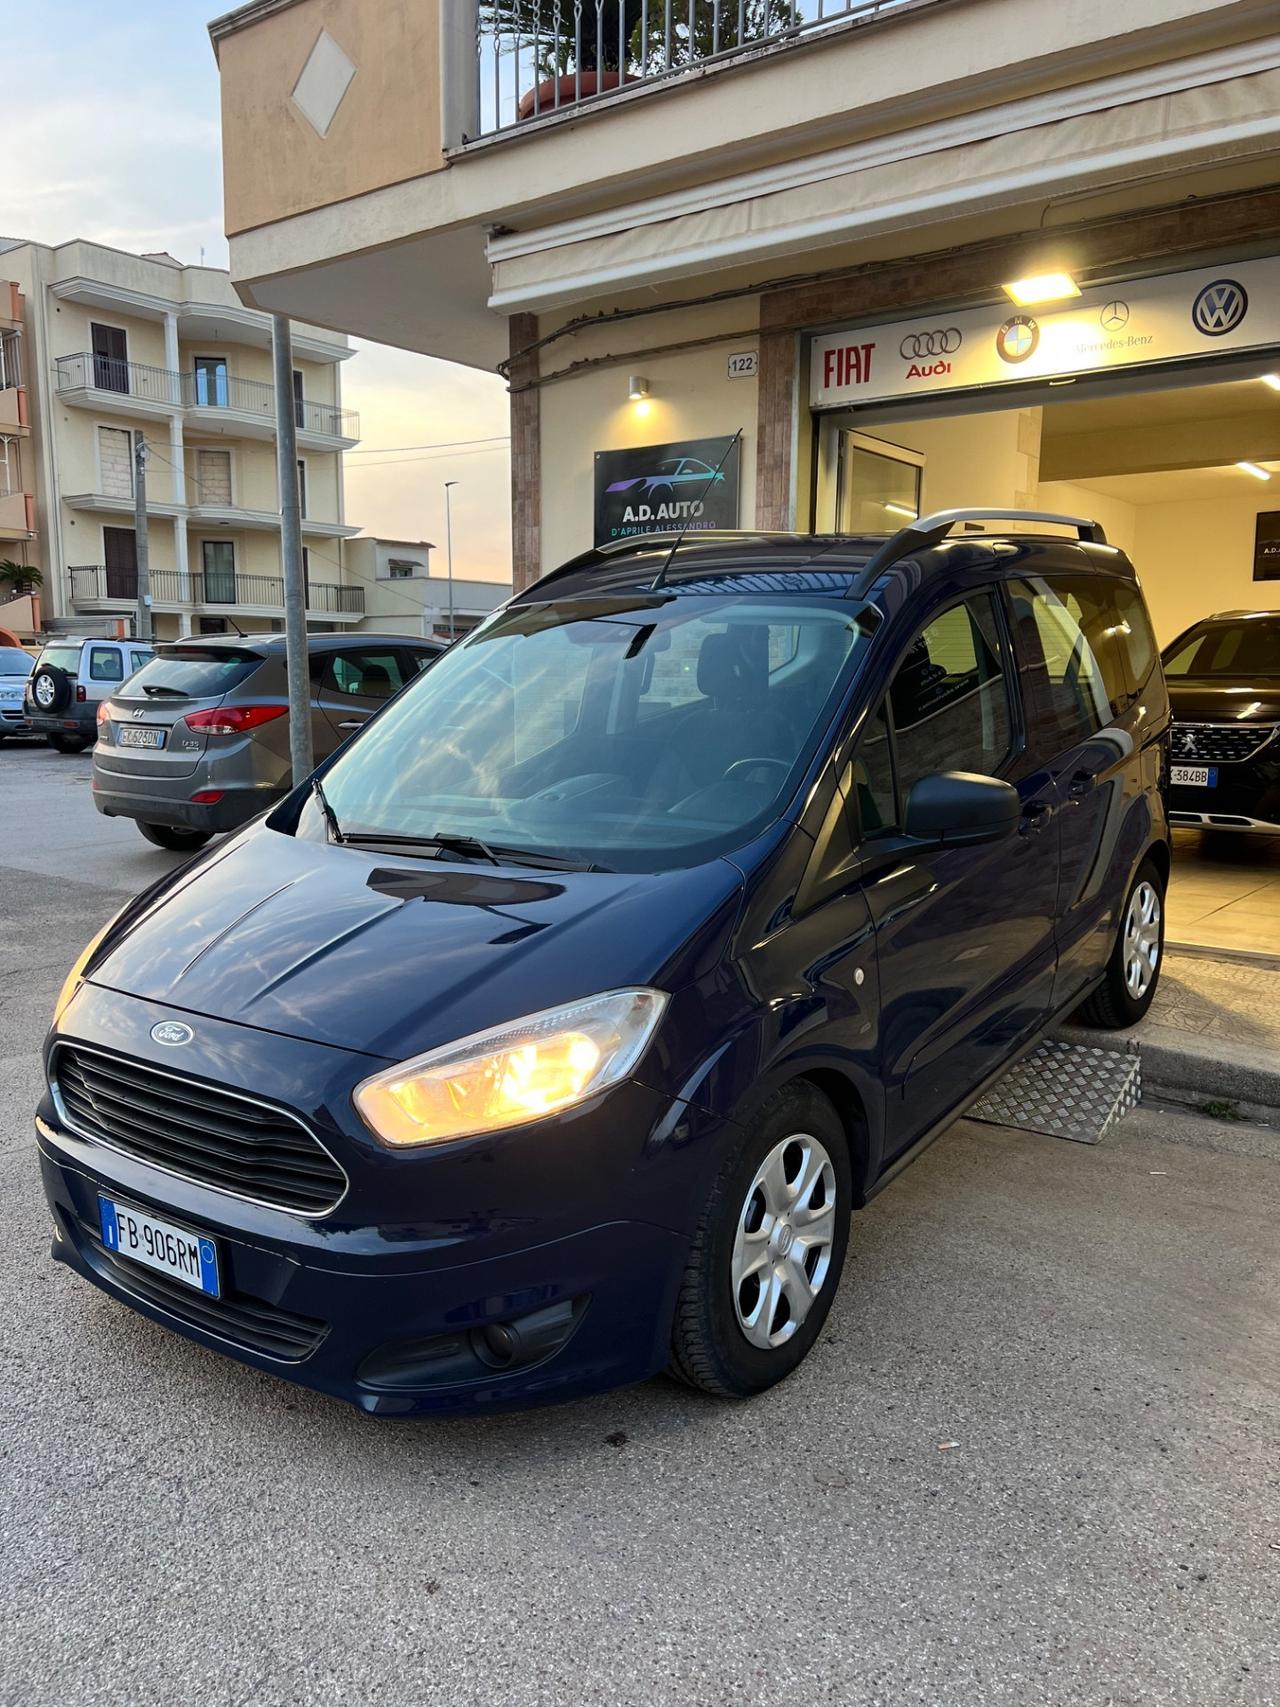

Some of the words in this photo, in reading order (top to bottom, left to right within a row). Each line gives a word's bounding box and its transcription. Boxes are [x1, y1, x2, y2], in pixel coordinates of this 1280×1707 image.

[731, 357, 753, 372] 122
[824, 343, 876, 388] FIAT
[905, 361, 951, 380] Audi
[656, 500, 704, 519] AUTO
[157, 1024, 184, 1041] Ford
